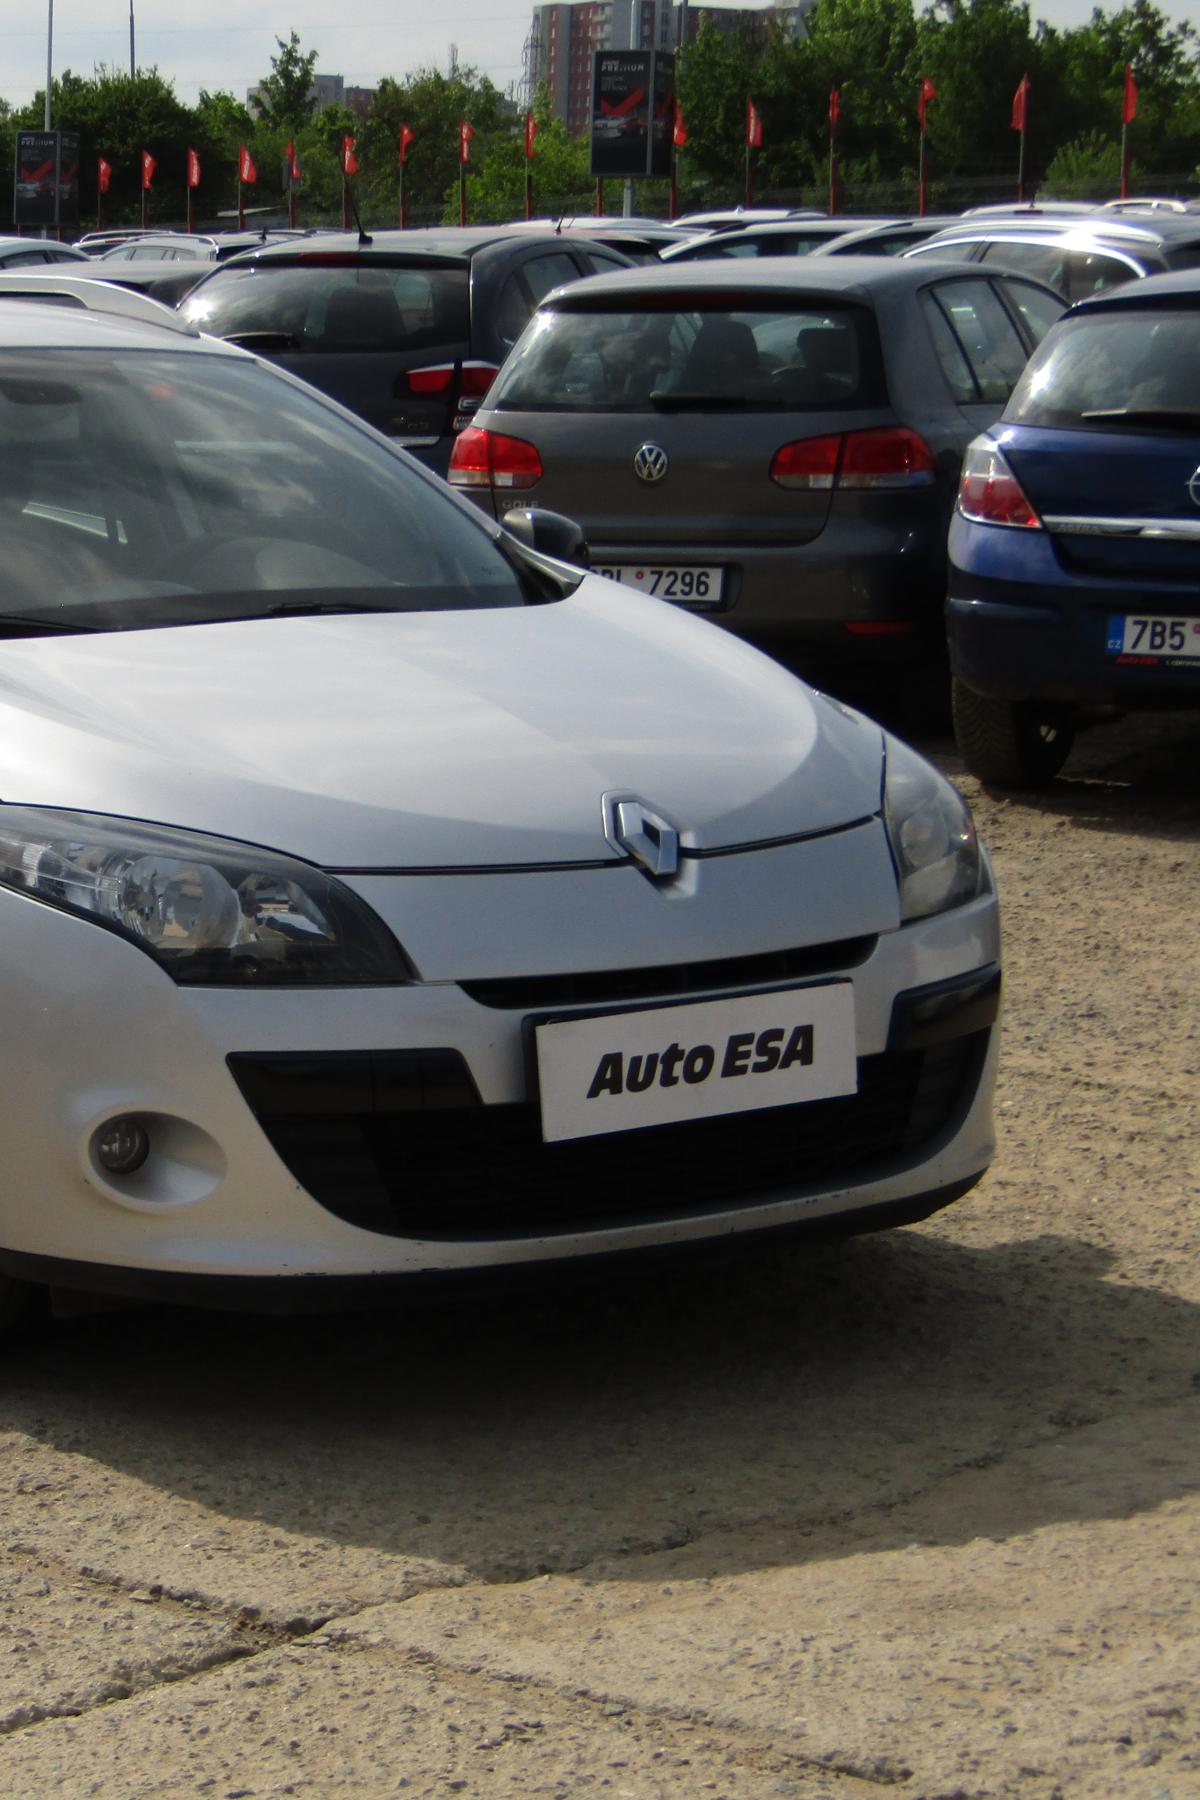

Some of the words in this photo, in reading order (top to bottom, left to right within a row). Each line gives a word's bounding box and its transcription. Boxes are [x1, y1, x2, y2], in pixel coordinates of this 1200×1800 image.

[650, 570, 710, 597] 7296
[1131, 619, 1186, 651] 7B5
[586, 1042, 715, 1099] Auto
[720, 1024, 814, 1078] ESA
